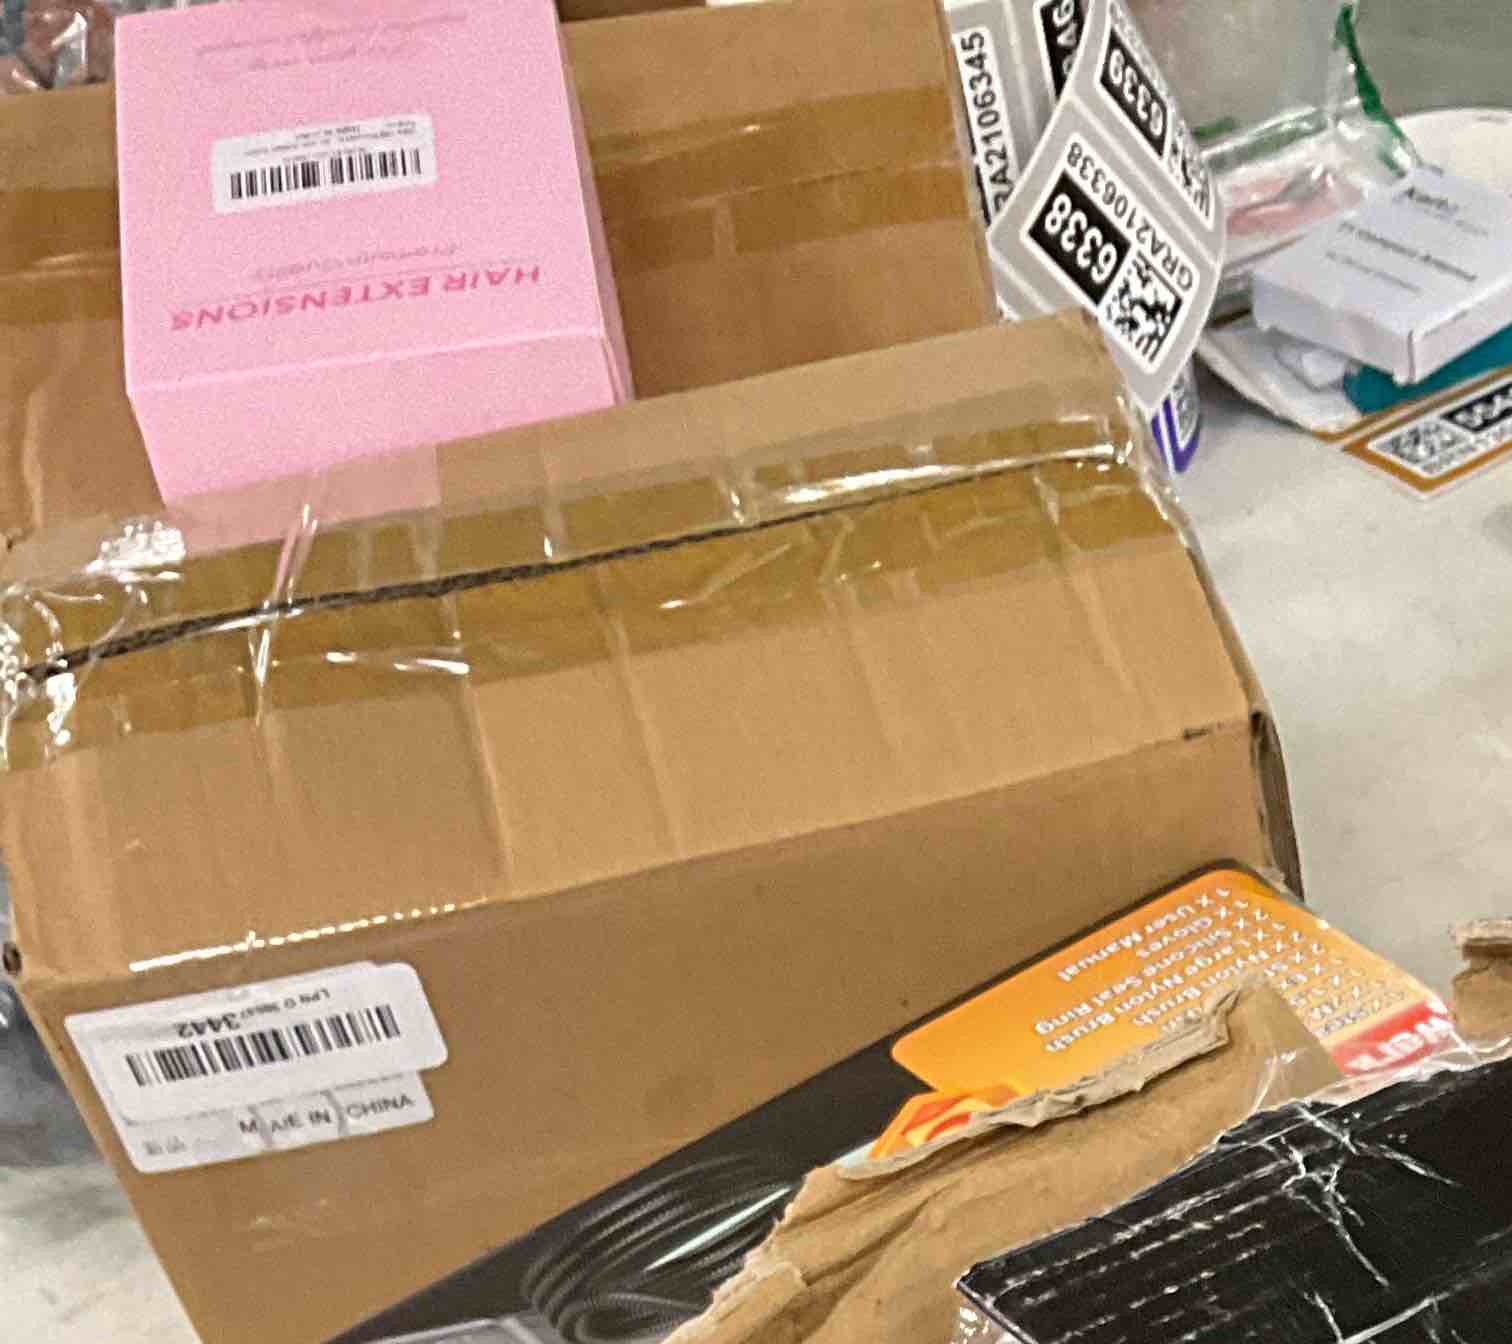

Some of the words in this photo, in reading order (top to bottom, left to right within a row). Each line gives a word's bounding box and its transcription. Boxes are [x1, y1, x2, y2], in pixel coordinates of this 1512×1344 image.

[960, 31, 1012, 211] RA2106345
[1045, 193, 1118, 283] 6338
[1067, 142, 1193, 291] GRA2106338
[440, 264, 541, 294] HAIR
[170, 273, 430, 331] EXTENSIONS
[1136, 916, 1213, 959] Gloves
[1145, 904, 1195, 934] User
[1057, 931, 1143, 983] Manual
[1143, 929, 1233, 978] Silicone
[1113, 973, 1185, 1015] Nylon
[1132, 986, 1202, 1027] Brush
[177, 1013, 238, 1038] 3442
[1034, 1001, 1094, 1035] Ring
[1045, 1011, 1116, 1054] Brush
[345, 1093, 415, 1120] CHINA
